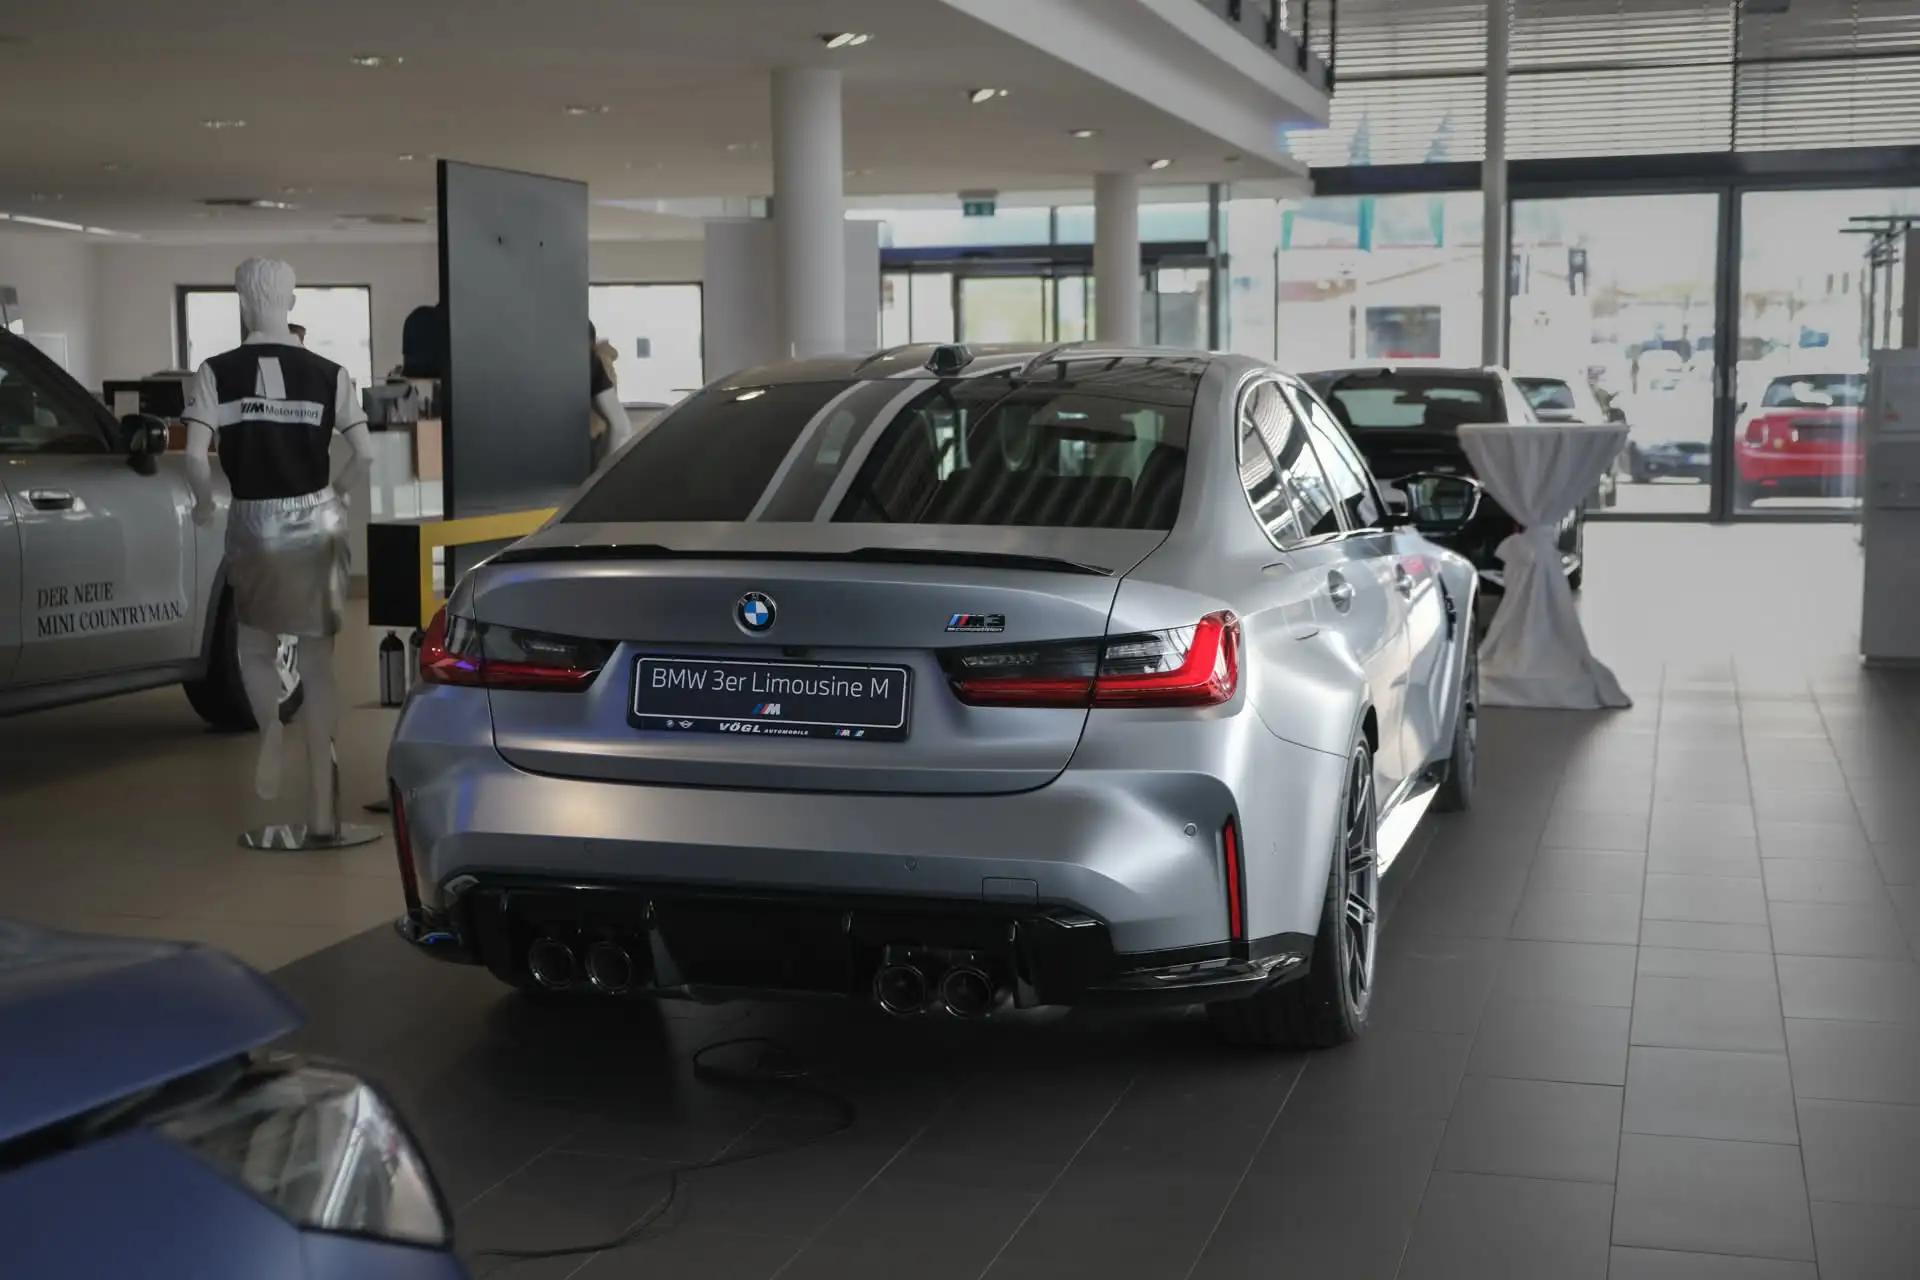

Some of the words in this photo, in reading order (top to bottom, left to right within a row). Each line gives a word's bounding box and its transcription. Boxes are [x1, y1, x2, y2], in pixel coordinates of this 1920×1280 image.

[265, 406, 319, 419] Motorsport
[37, 586, 69, 609] DER
[74, 582, 114, 604] NEUE
[37, 613, 75, 637] MINI
[652, 667, 707, 690] BMW
[711, 670, 747, 692] 3er
[752, 672, 863, 698] Limousine
[870, 677, 889, 699] M
[719, 722, 761, 733] VÖGL
